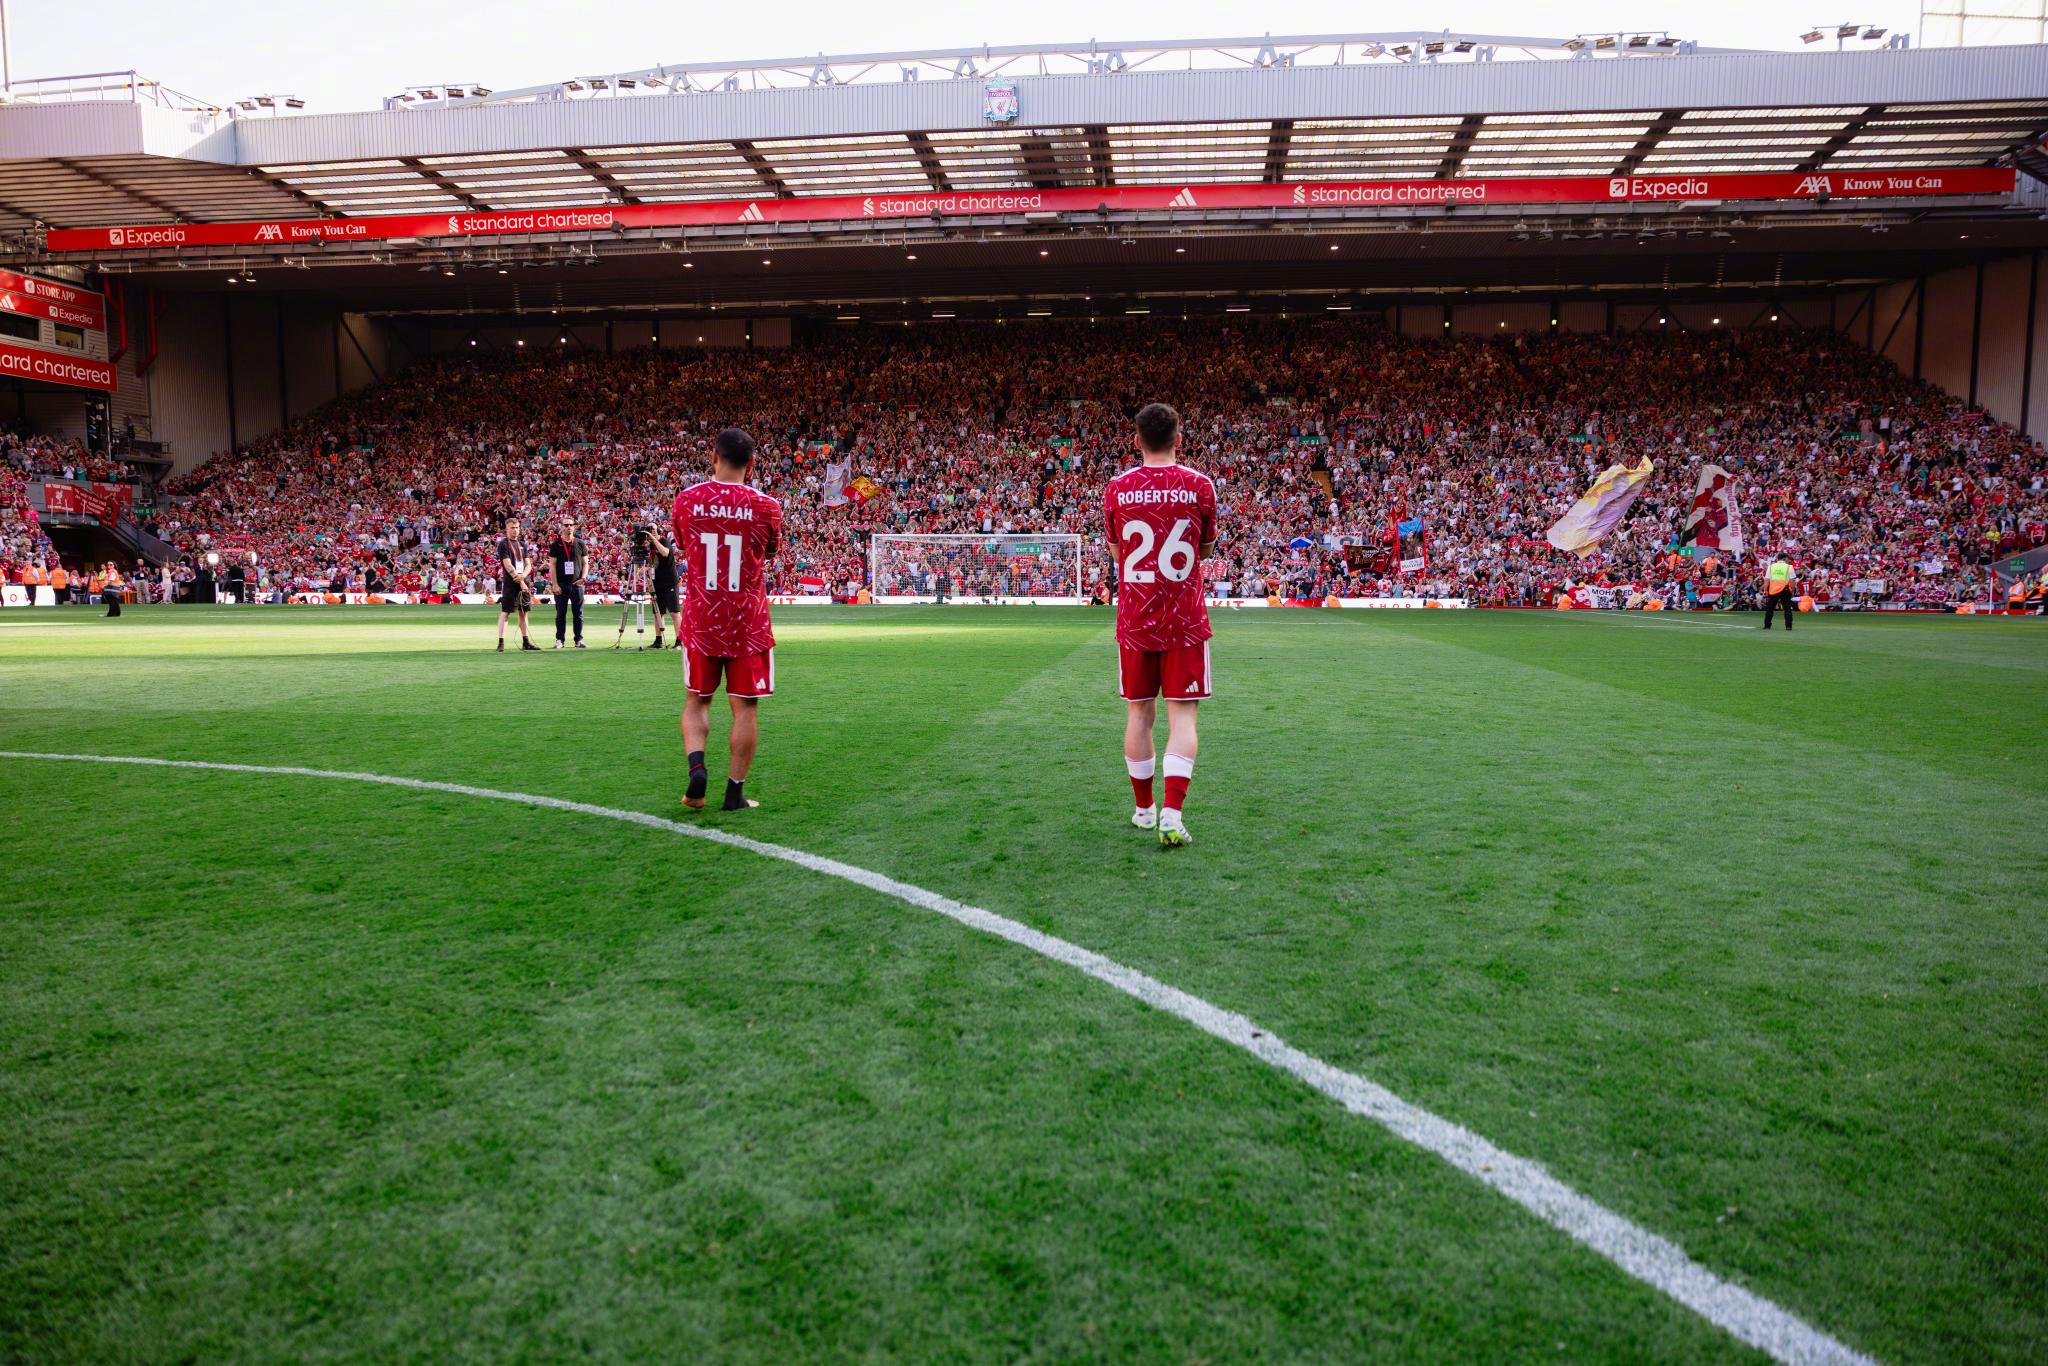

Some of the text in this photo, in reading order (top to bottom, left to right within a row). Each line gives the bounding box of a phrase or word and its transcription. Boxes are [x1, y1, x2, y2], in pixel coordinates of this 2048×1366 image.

[1631, 178, 1708, 197] Expedia
[1793, 176, 1833, 194] AXA
[1843, 176, 1942, 190] Know You Can
[1311, 184, 1486, 202] standard chartered
[879, 193, 1041, 214] standard chartered
[463, 211, 613, 231] standard chartered
[126, 228, 186, 245] Expedia
[254, 224, 283, 240] AXA
[291, 224, 366, 237] Know You Can
[36, 284, 76, 302] STORE APP
[59, 308, 93, 324] Expedia
[0, 354, 111, 384] ard chartered
[1117, 490, 1198, 505] ROBERTSON
[1122, 519, 1196, 583] 26
[700, 533, 743, 592] 11
